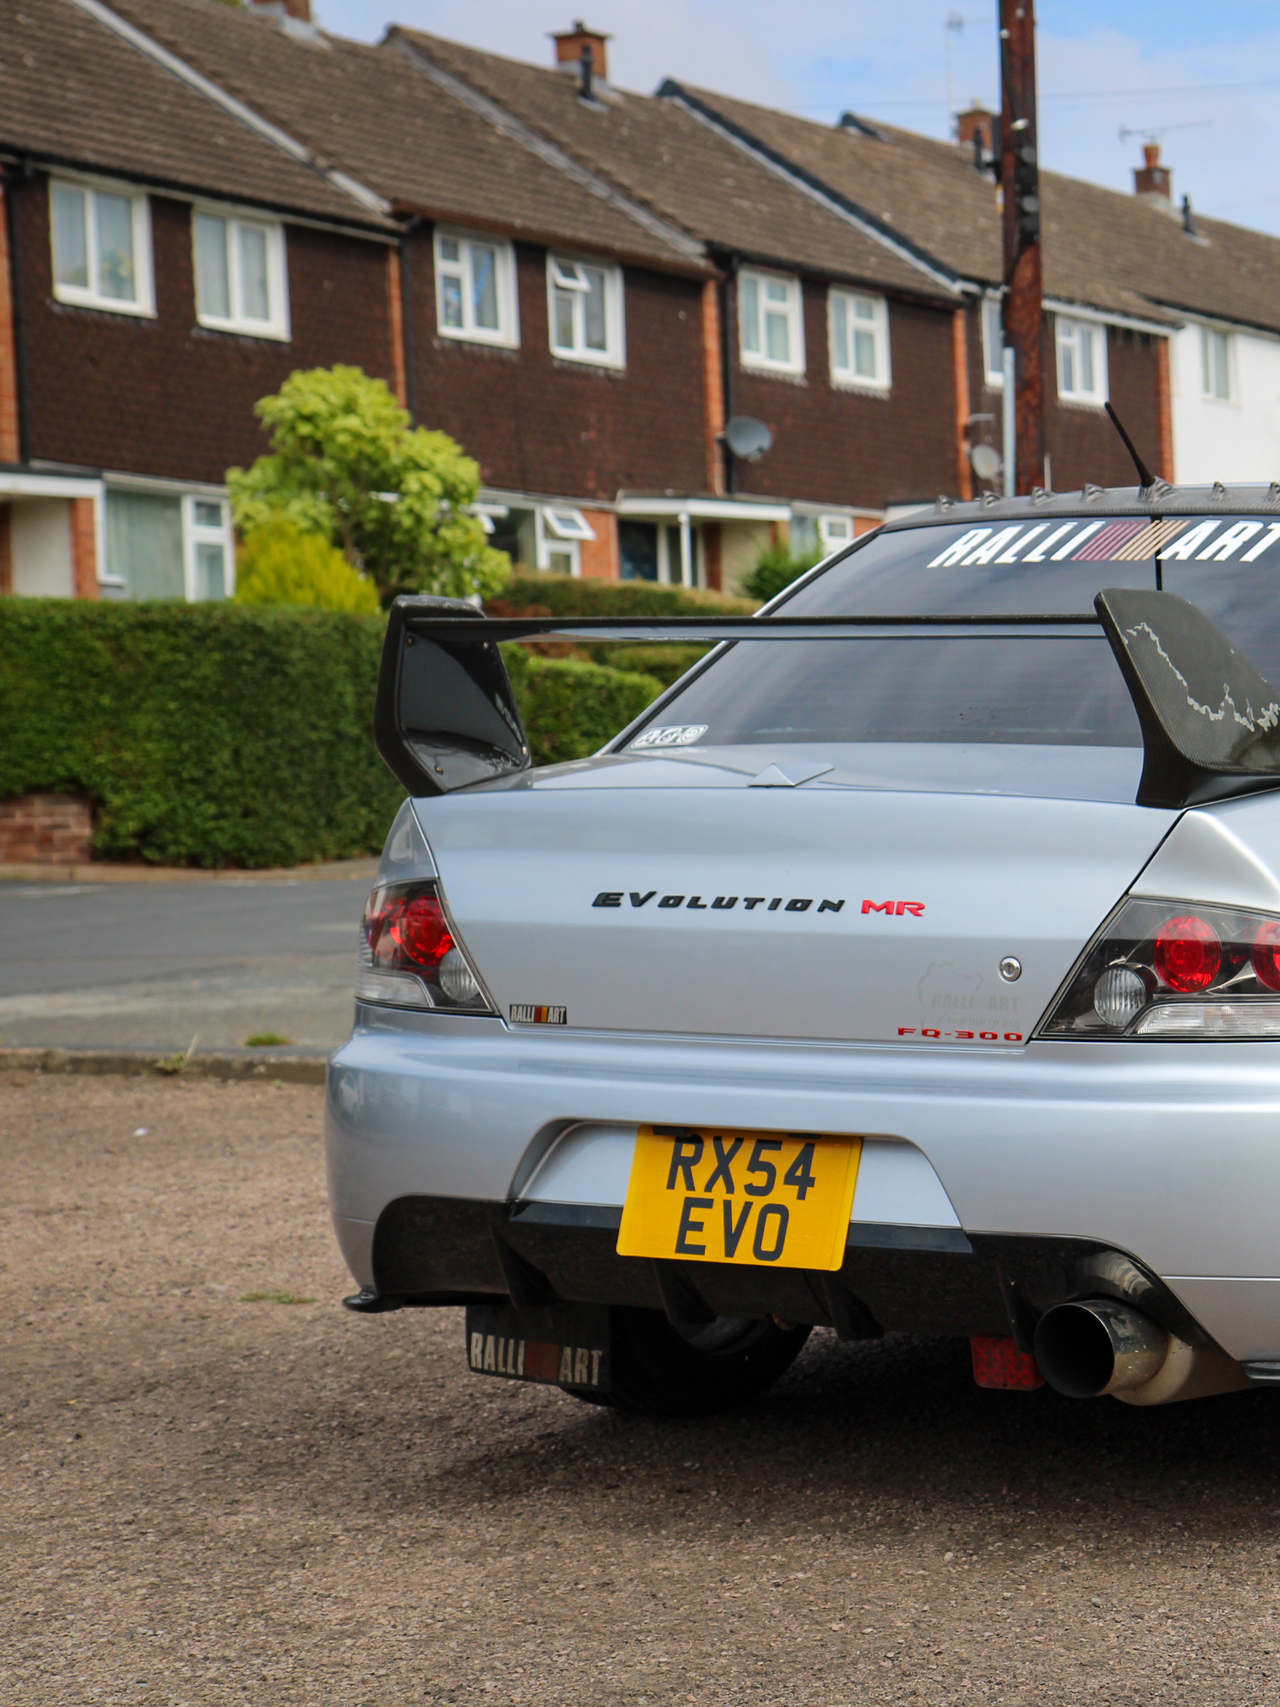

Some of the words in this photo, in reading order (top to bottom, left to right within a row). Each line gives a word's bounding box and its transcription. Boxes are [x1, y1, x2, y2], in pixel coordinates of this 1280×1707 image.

[926, 520, 1106, 568] RALLI
[591, 890, 846, 914] EVOLUTION
[861, 898, 926, 917] MR
[510, 1005, 535, 1024] RALLI
[548, 1007, 567, 1025] ART
[897, 1026, 1023, 1042] FQ-300
[666, 1134, 817, 1201] RX54
[674, 1196, 790, 1262] EVO
[470, 1332, 524, 1376] RALLI
[558, 1348, 603, 1386] ART
